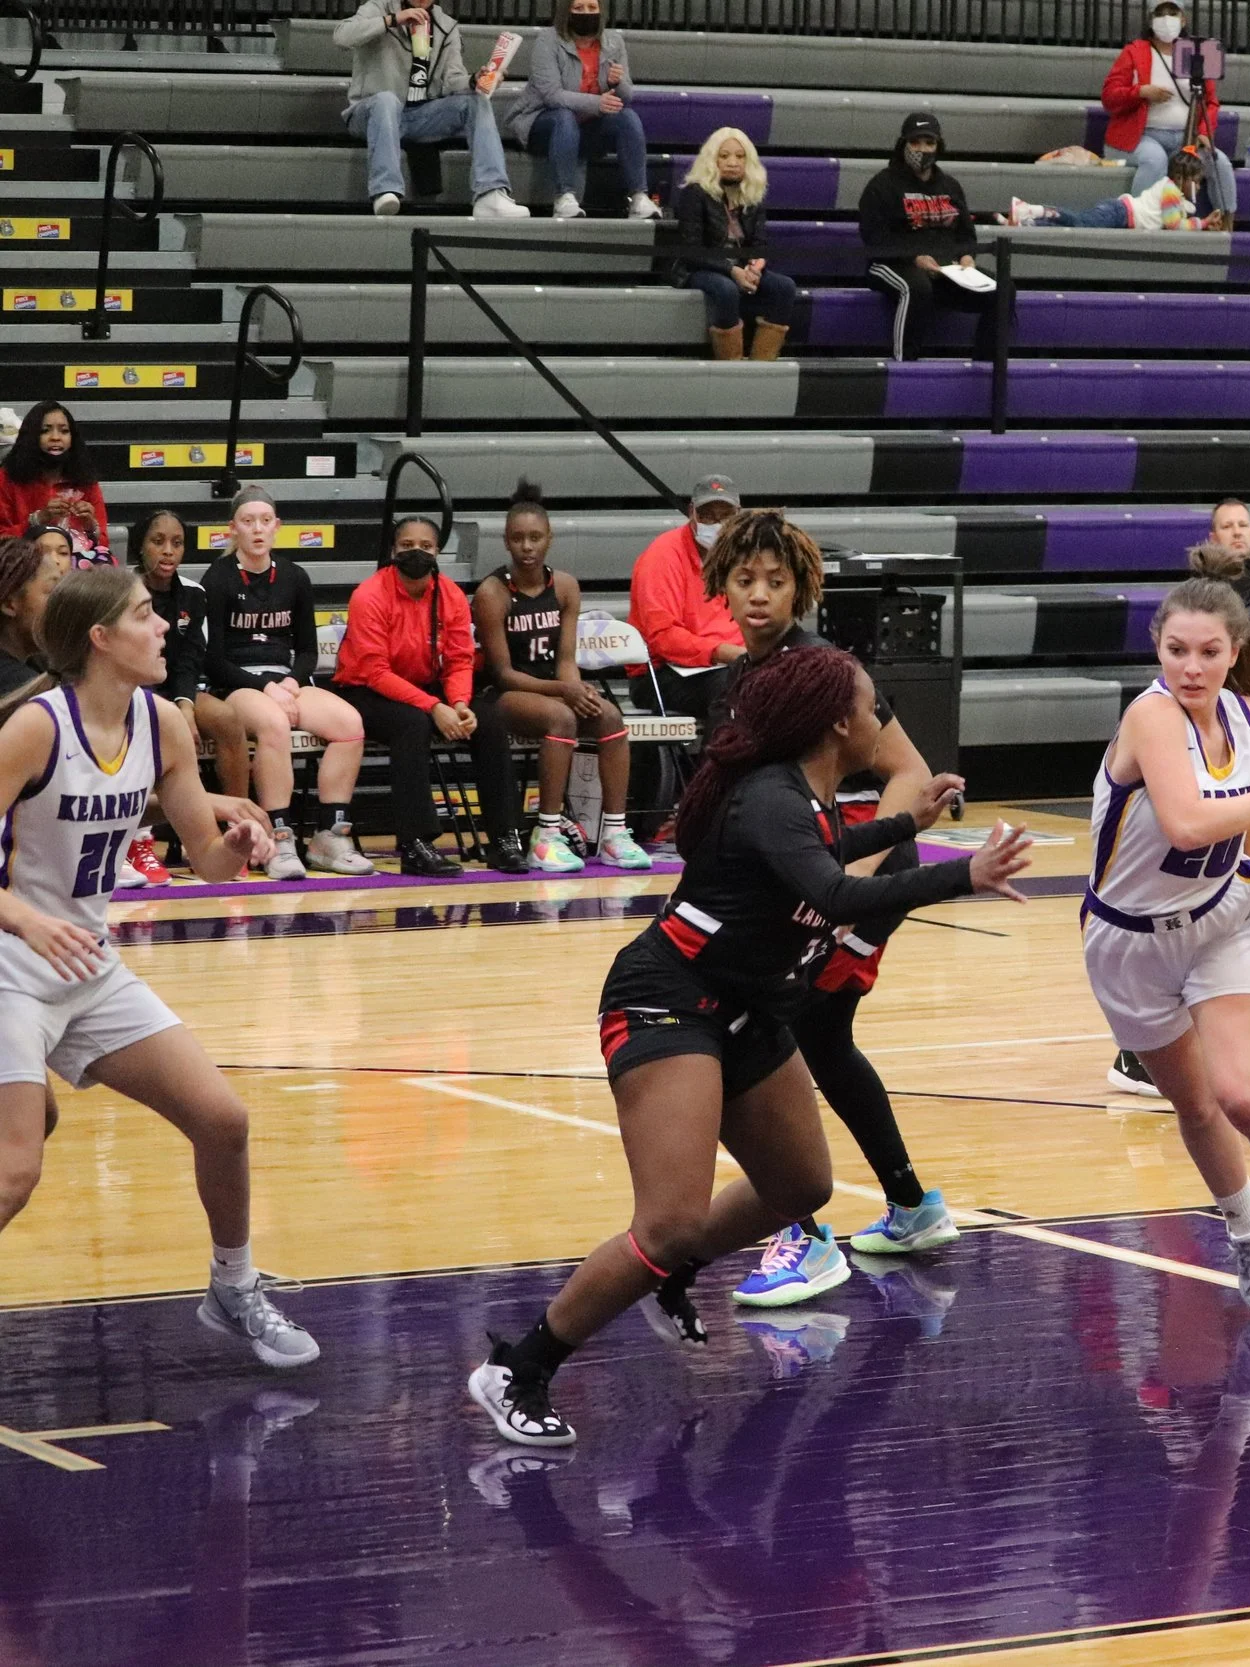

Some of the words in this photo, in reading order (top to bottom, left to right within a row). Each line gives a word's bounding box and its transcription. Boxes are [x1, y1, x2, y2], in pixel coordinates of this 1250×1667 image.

[230, 611, 259, 629] LADY
[261, 610, 292, 629] CARDS
[508, 614, 534, 632] LADY
[529, 636, 549, 662] 15
[579, 635, 631, 649] ARNEY
[625, 723, 693, 737] ULLDOGS
[56, 787, 147, 821] KEARNEY
[72, 829, 128, 898] 21
[792, 900, 826, 928] LAD
